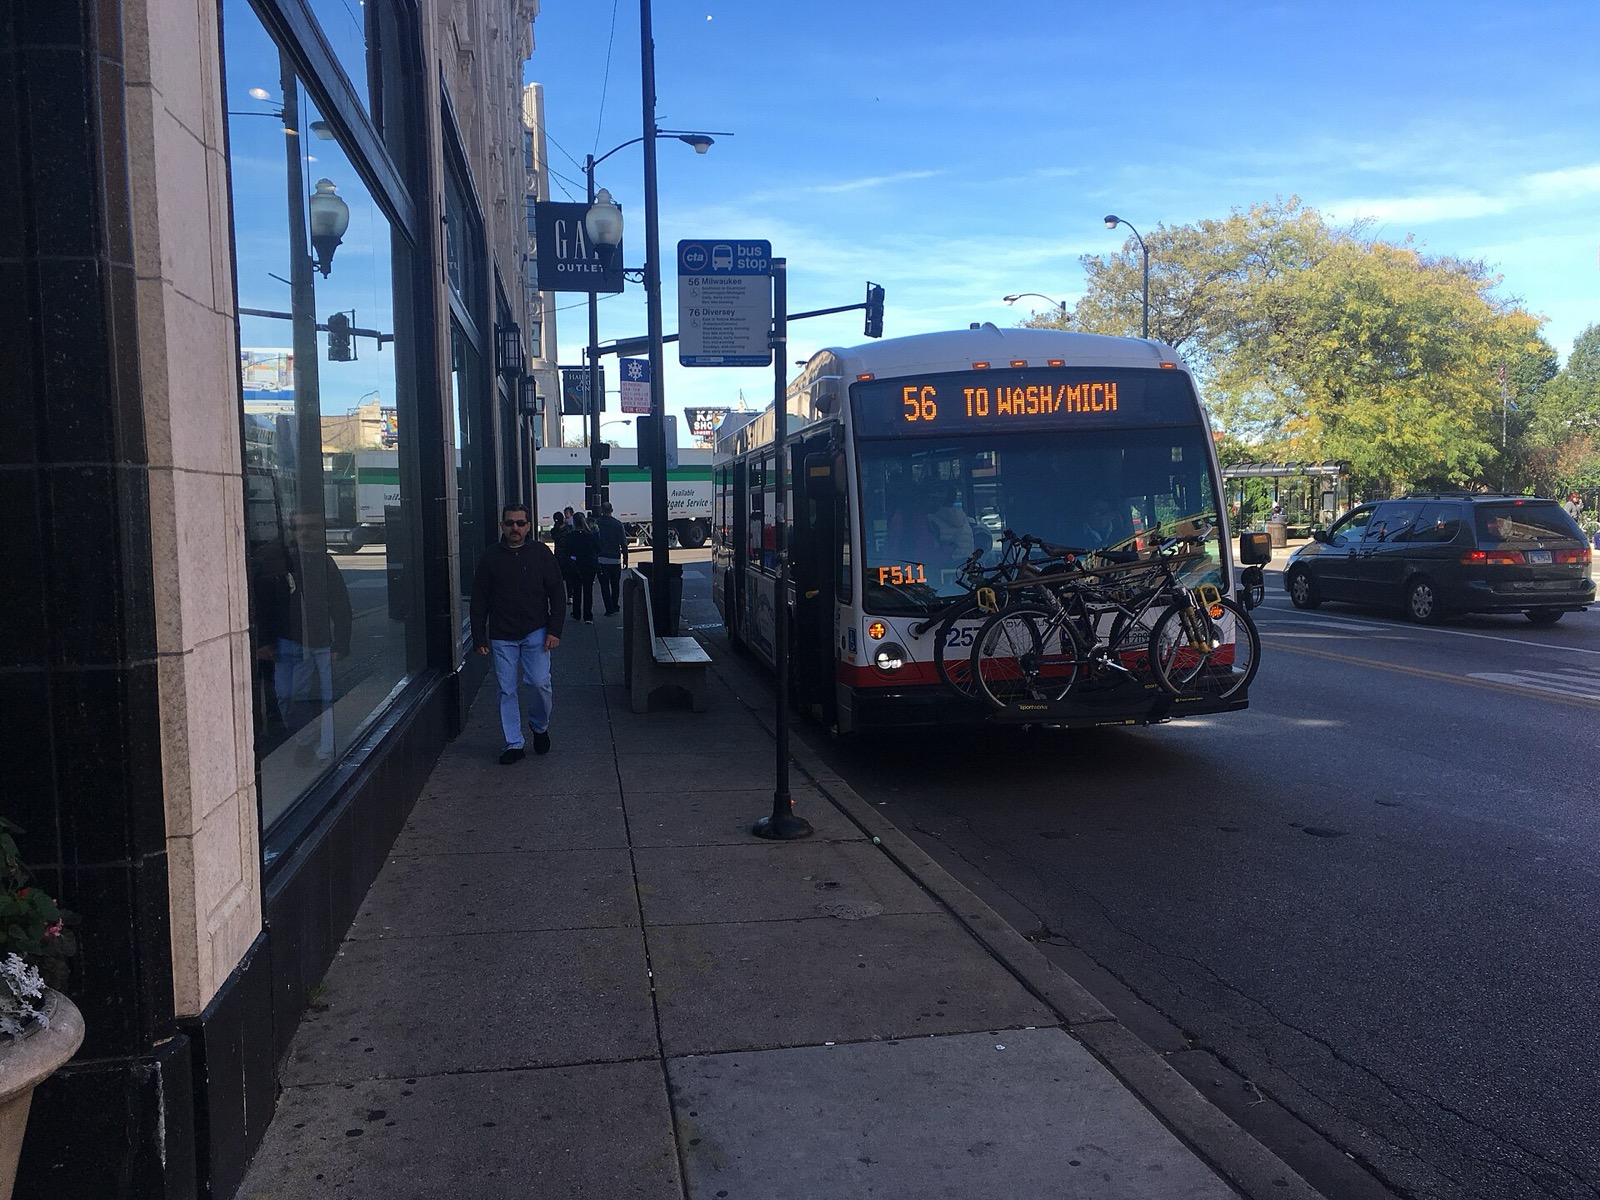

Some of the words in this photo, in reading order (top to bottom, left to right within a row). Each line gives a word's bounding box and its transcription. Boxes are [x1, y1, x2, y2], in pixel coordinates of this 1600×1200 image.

[555, 219, 600, 260] GA
[686, 252, 704, 262] cta
[737, 244, 762, 257] bus
[737, 257, 767, 271] stop
[688, 278, 700, 286] 56
[688, 308, 700, 317] 76
[702, 308, 735, 317] Diversey
[903, 385, 937, 421] 56
[963, 387, 989, 417] TO
[997, 382, 1118, 416] WASH/MICH
[694, 421, 713, 431] SHO
[671, 489, 695, 497] Available
[667, 499, 685, 511] tgate
[687, 498, 709, 508] Service
[878, 564, 928, 586] F511
